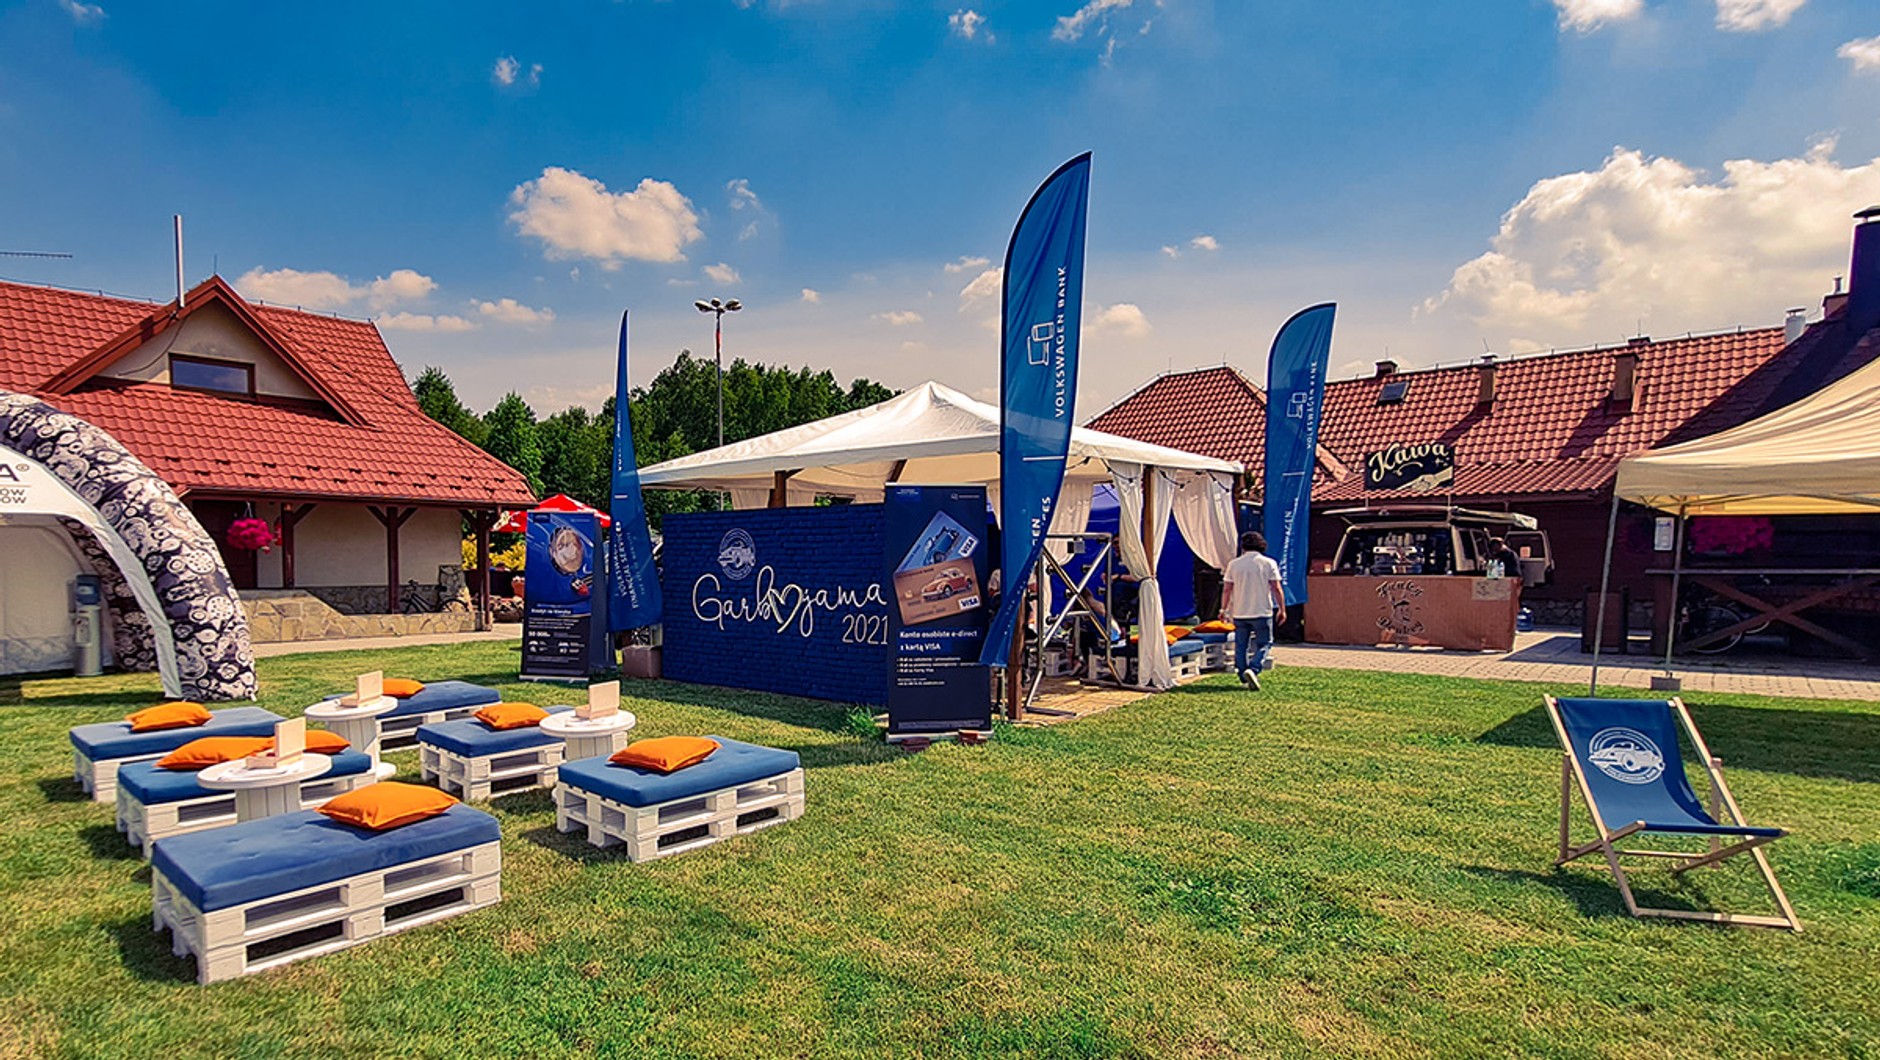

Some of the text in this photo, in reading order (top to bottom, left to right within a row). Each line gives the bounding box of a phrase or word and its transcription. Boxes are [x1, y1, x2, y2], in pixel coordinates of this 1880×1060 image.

[1055, 266, 1067, 418] VOLKSWAGEN BANK
[1368, 442, 1449, 482] Kawa
[961, 597, 979, 608] VISA
[842, 613, 889, 645] 2021
[951, 629, 978, 638] e-direct
